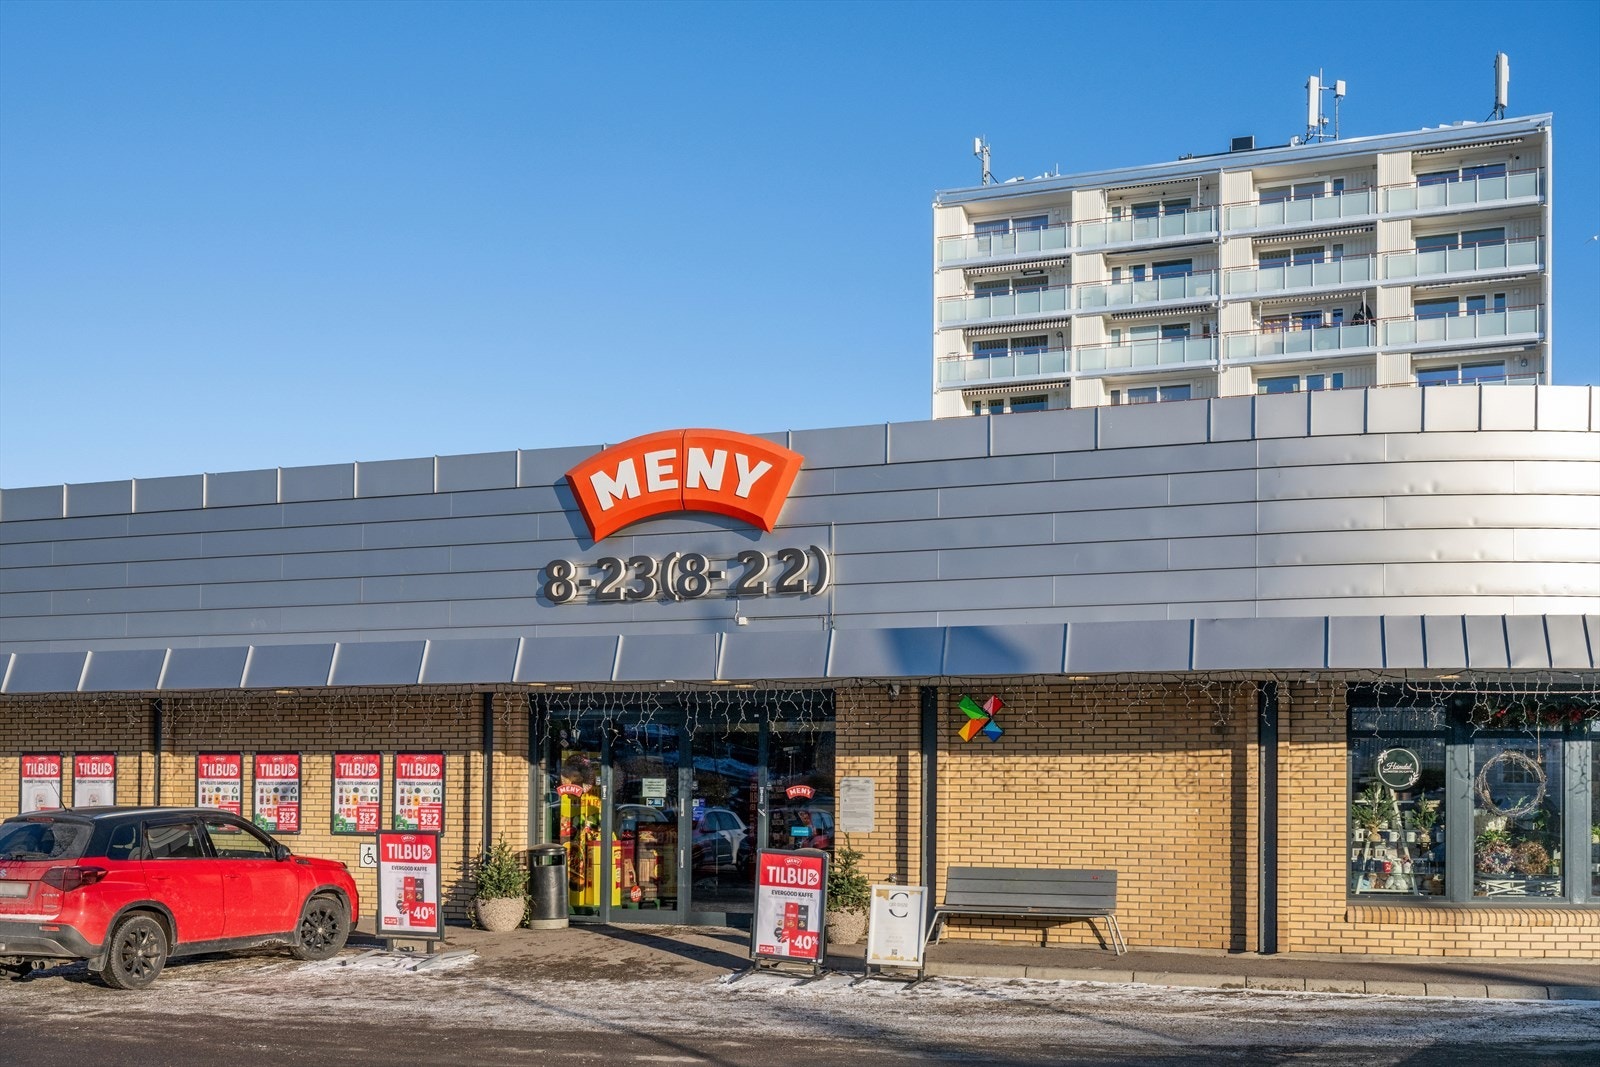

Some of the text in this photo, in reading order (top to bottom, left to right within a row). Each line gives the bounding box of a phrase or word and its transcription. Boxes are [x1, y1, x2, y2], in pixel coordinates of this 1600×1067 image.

[589, 447, 773, 511] MENY
[26, 763, 58, 775] TILBUD
[79, 763, 112, 775] TILBUD
[202, 764, 238, 776] TILBUD
[260, 764, 297, 776] TILBUD
[339, 763, 378, 776] TILBUD
[401, 763, 440, 776] TILBUD
[789, 788, 812, 796] MENY
[386, 844, 432, 860] TILBUD
[767, 866, 819, 886] TILBUD
[410, 906, 434, 920] -40%
[791, 935, 818, 950] -40%
